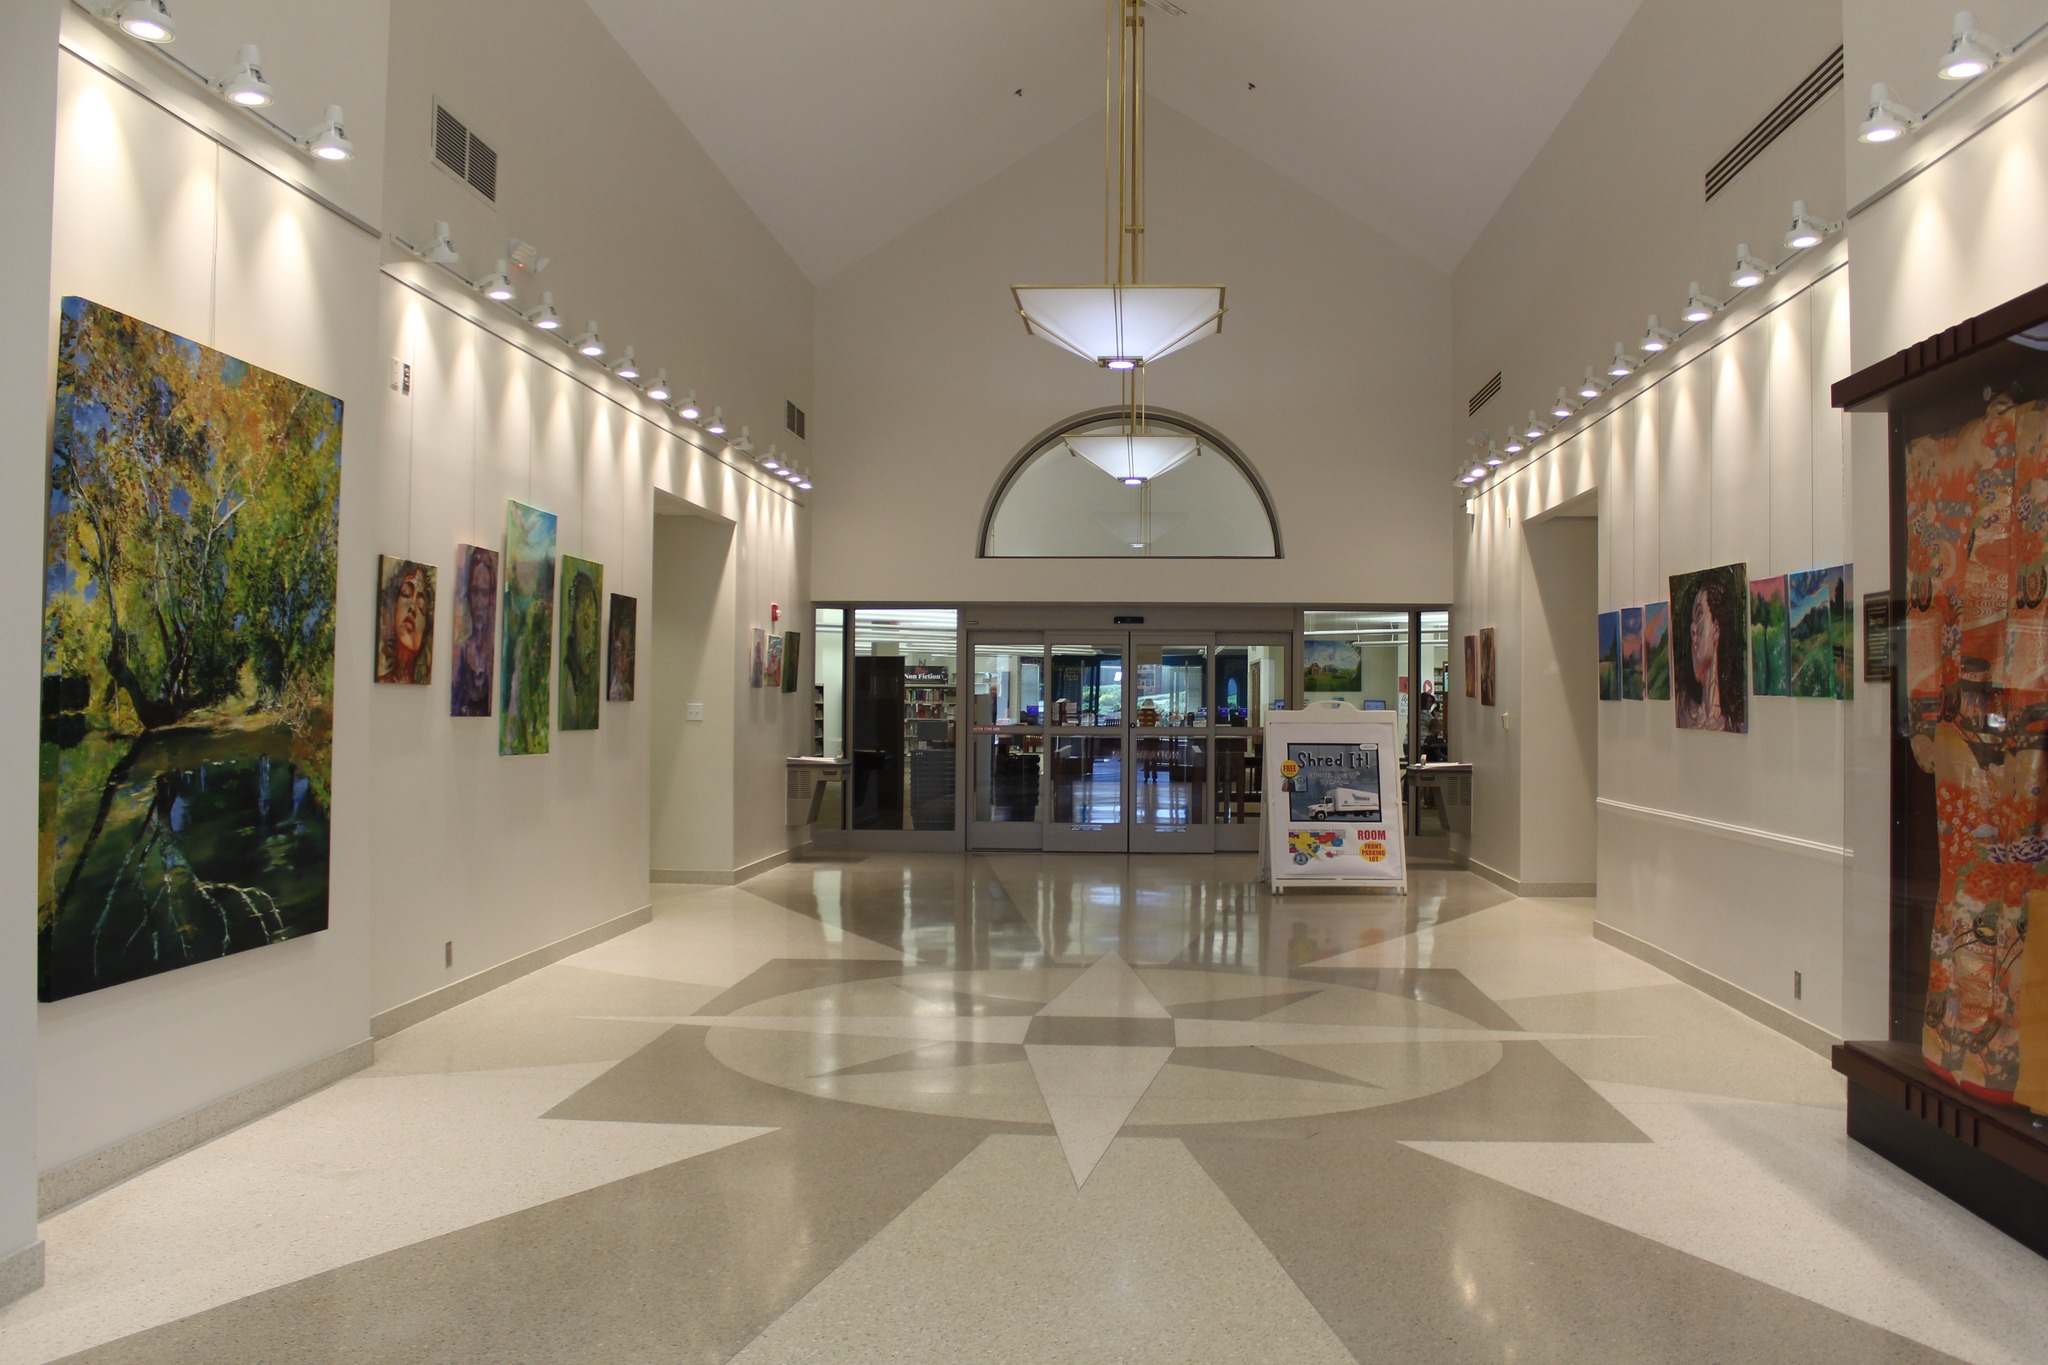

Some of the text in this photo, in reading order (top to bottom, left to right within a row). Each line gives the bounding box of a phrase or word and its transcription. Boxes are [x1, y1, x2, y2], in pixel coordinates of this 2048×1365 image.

[918, 672, 941, 680] Fiction
[1298, 751, 1371, 769] Shred It!
[1283, 764, 1297, 773] FREE
[1357, 830, 1386, 841] ROOM
